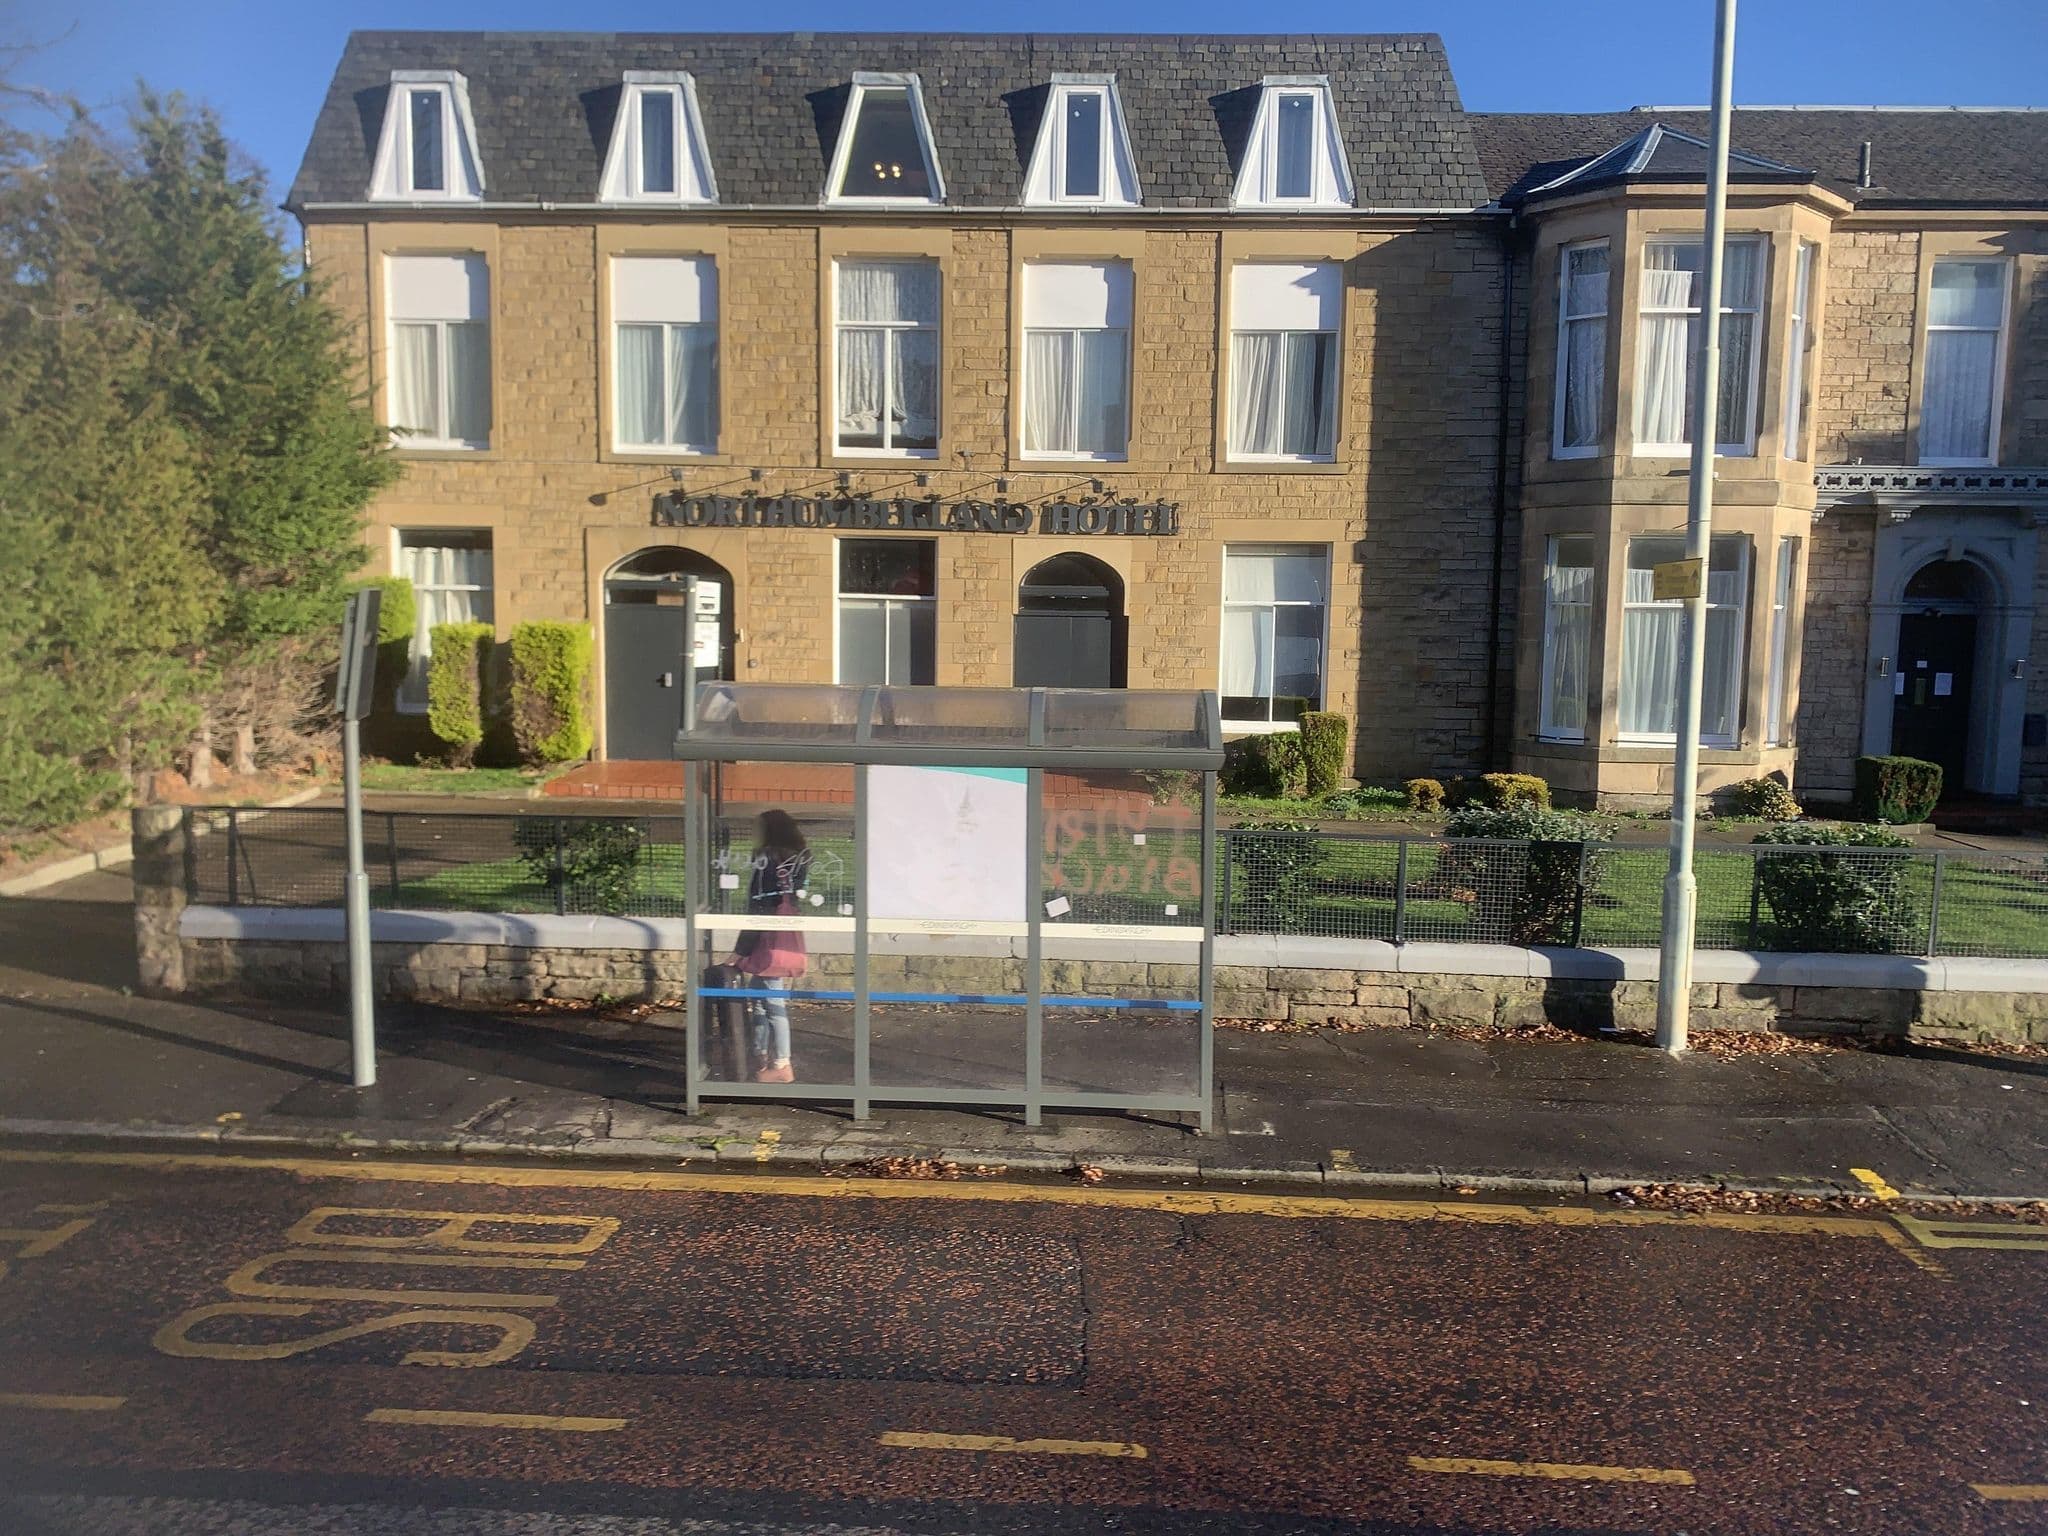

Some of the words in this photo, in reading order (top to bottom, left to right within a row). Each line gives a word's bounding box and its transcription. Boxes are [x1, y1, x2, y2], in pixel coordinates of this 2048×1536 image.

[656, 495, 1032, 532] NORTHUMBERLAND
[1049, 502, 1179, 535] HOTEL
[152, 1206, 622, 1368] BUS
